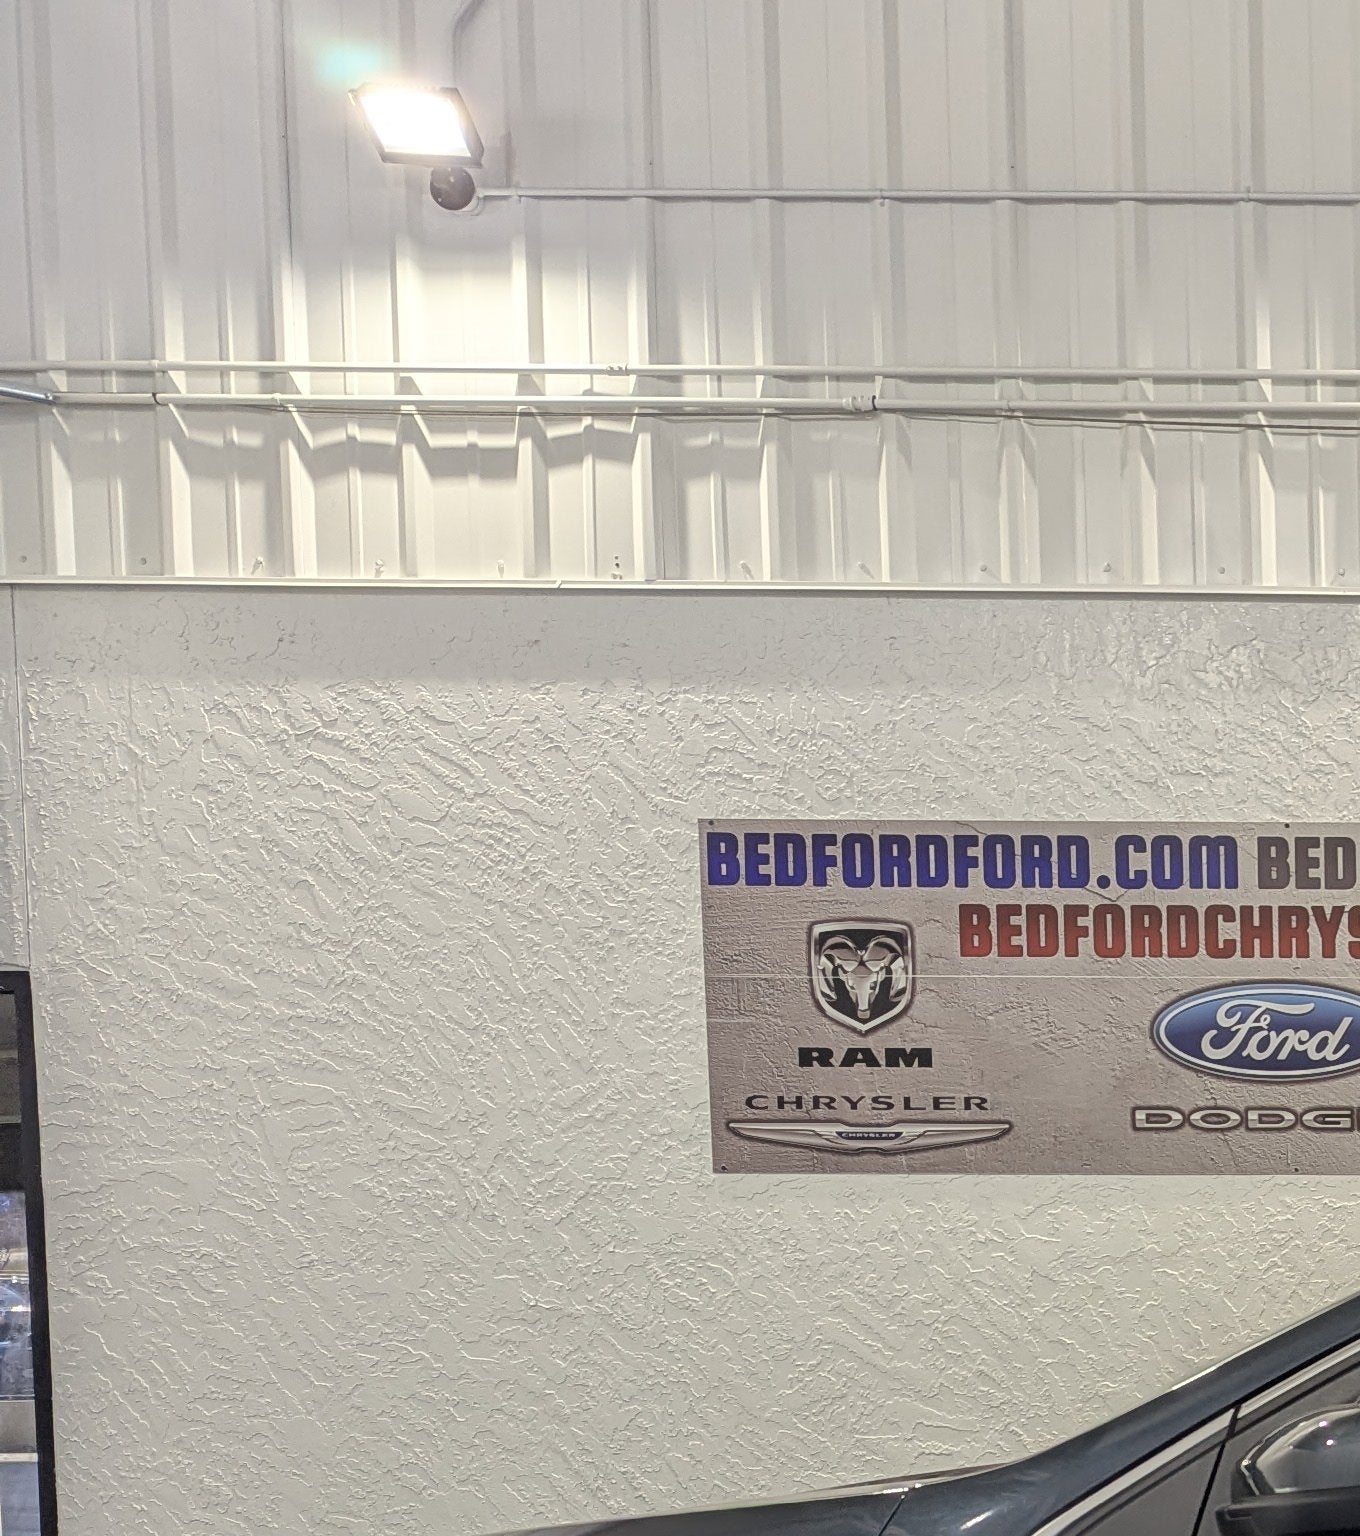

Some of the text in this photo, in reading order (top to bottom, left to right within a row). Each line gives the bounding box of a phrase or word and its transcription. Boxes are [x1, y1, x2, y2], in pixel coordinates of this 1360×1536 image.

[707, 831, 1239, 890] BEDFORDFORD.COM
[1200, 999, 1353, 1061] Ford
[798, 1047, 933, 1069] RAM
[745, 1095, 989, 1111] CHRYSLER
